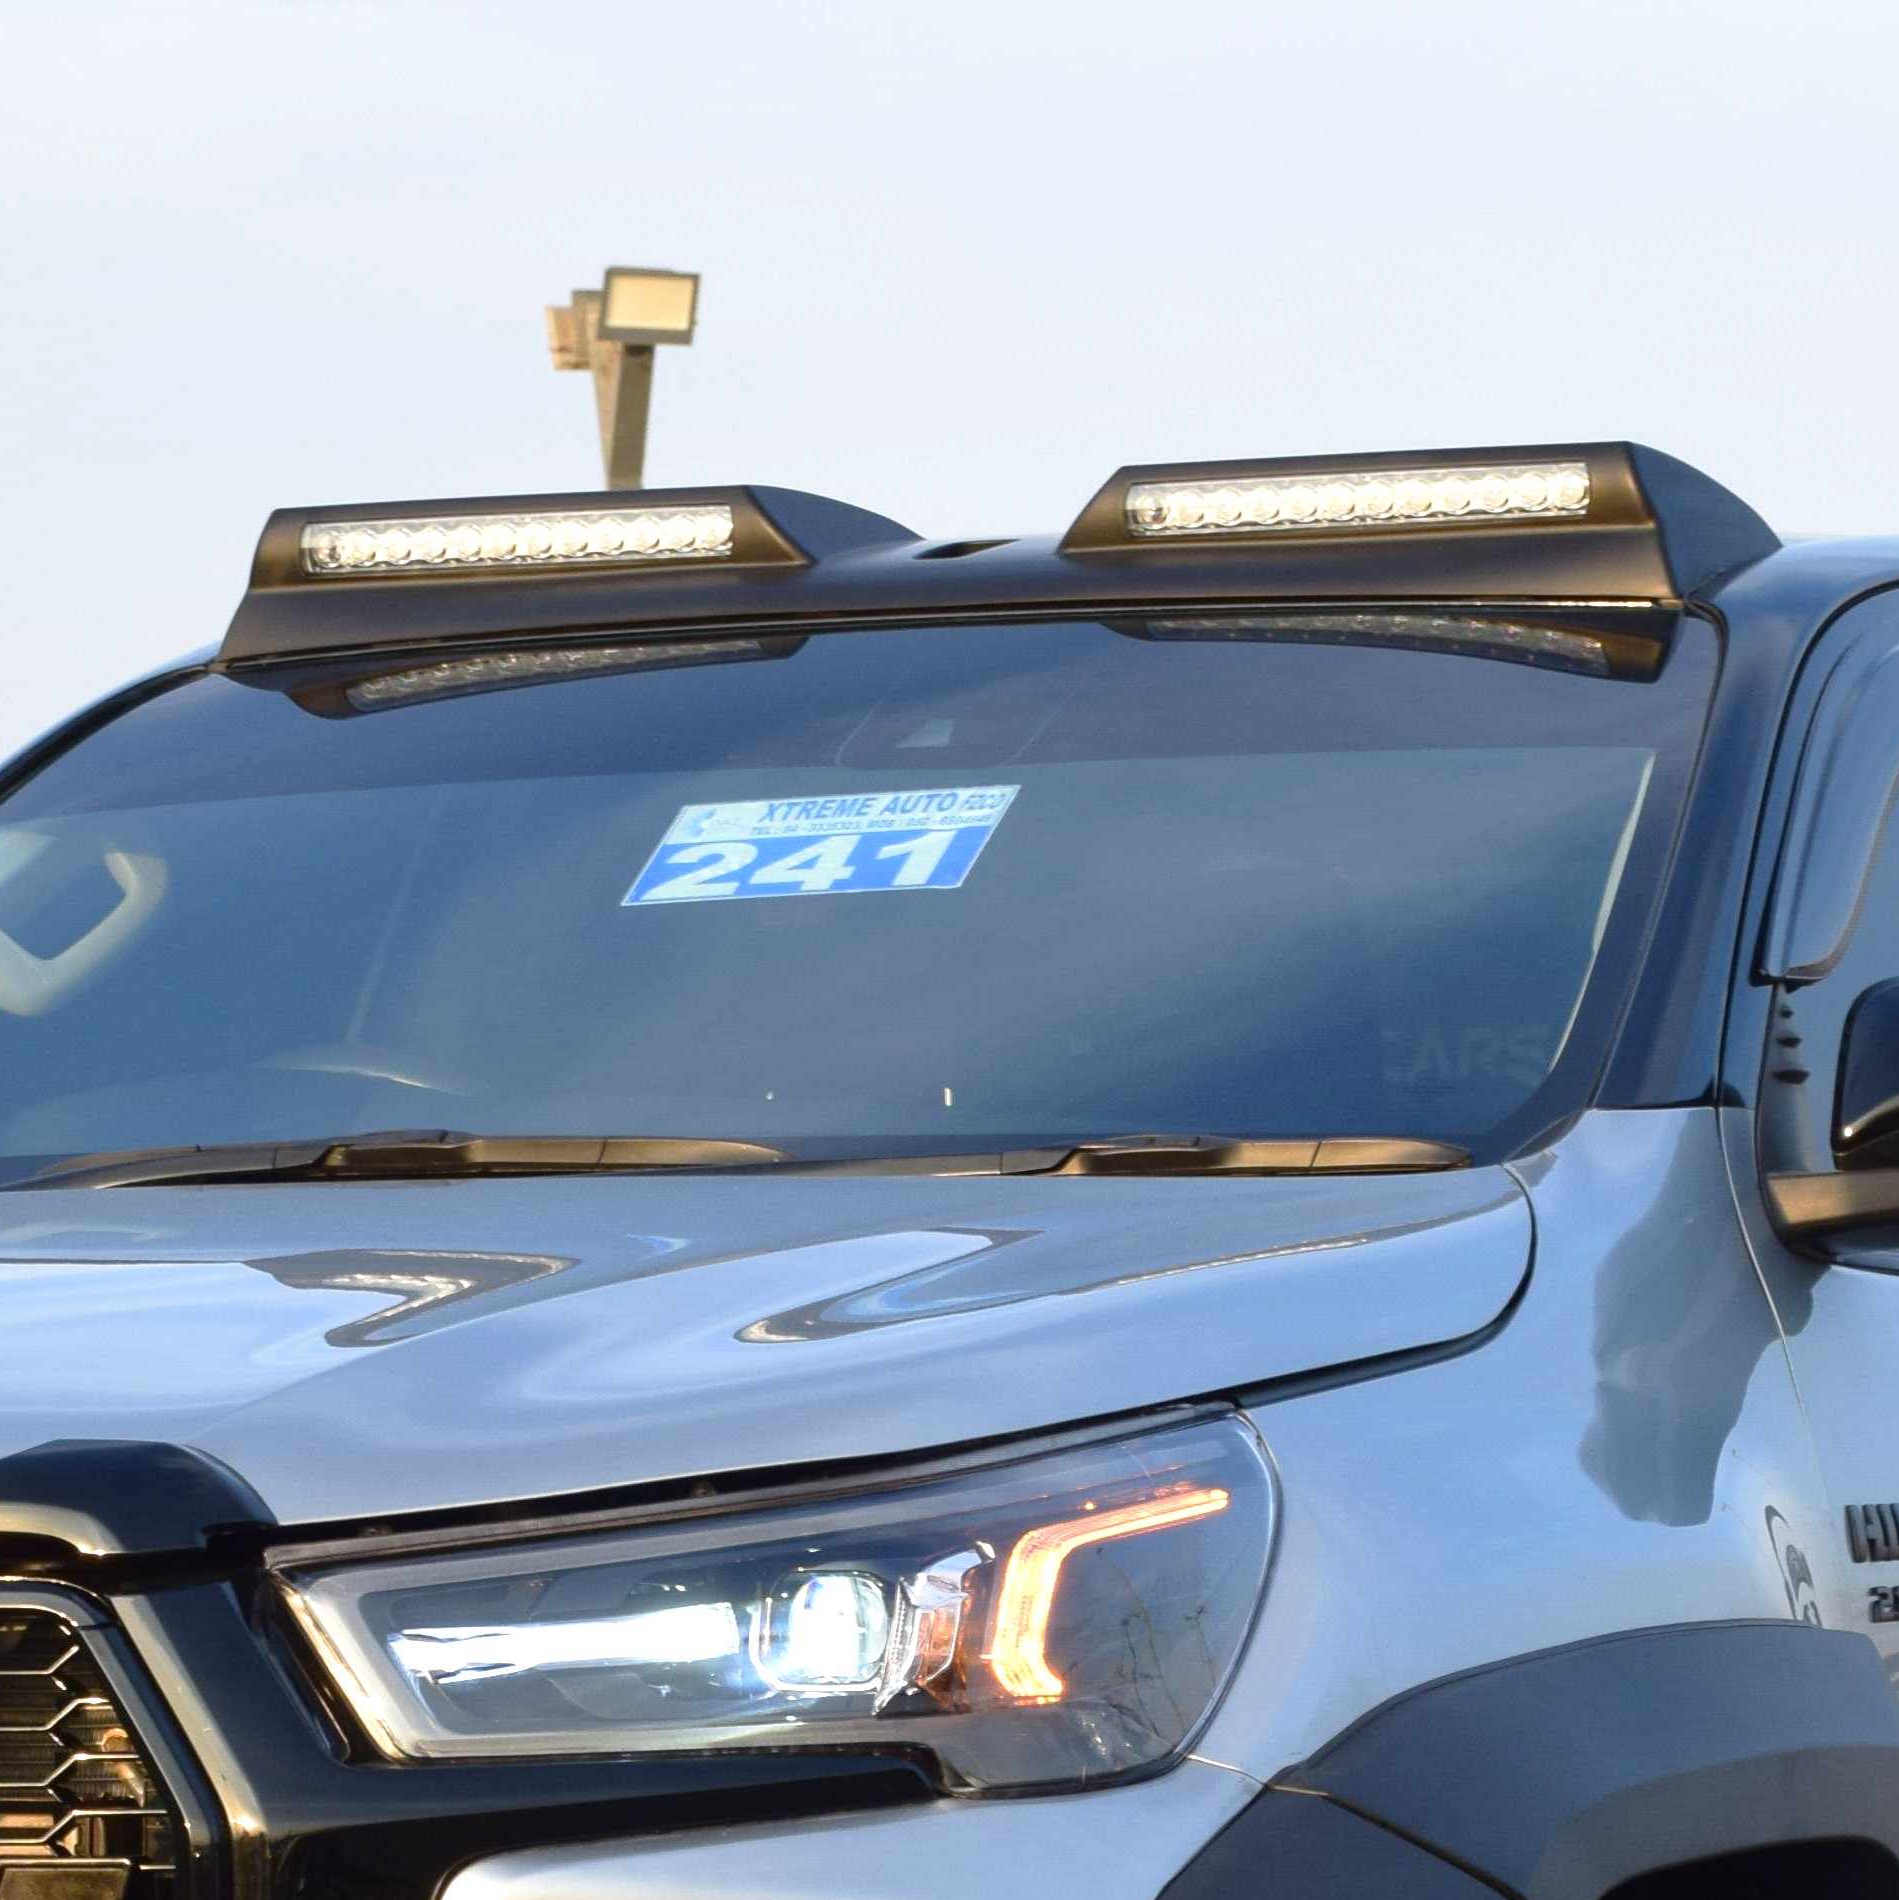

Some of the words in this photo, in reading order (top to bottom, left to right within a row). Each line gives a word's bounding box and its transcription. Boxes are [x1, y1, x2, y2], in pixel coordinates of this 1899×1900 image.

[758, 797, 877, 823] XTREME
[880, 792, 961, 817] AUTO
[639, 829, 958, 900] 241
